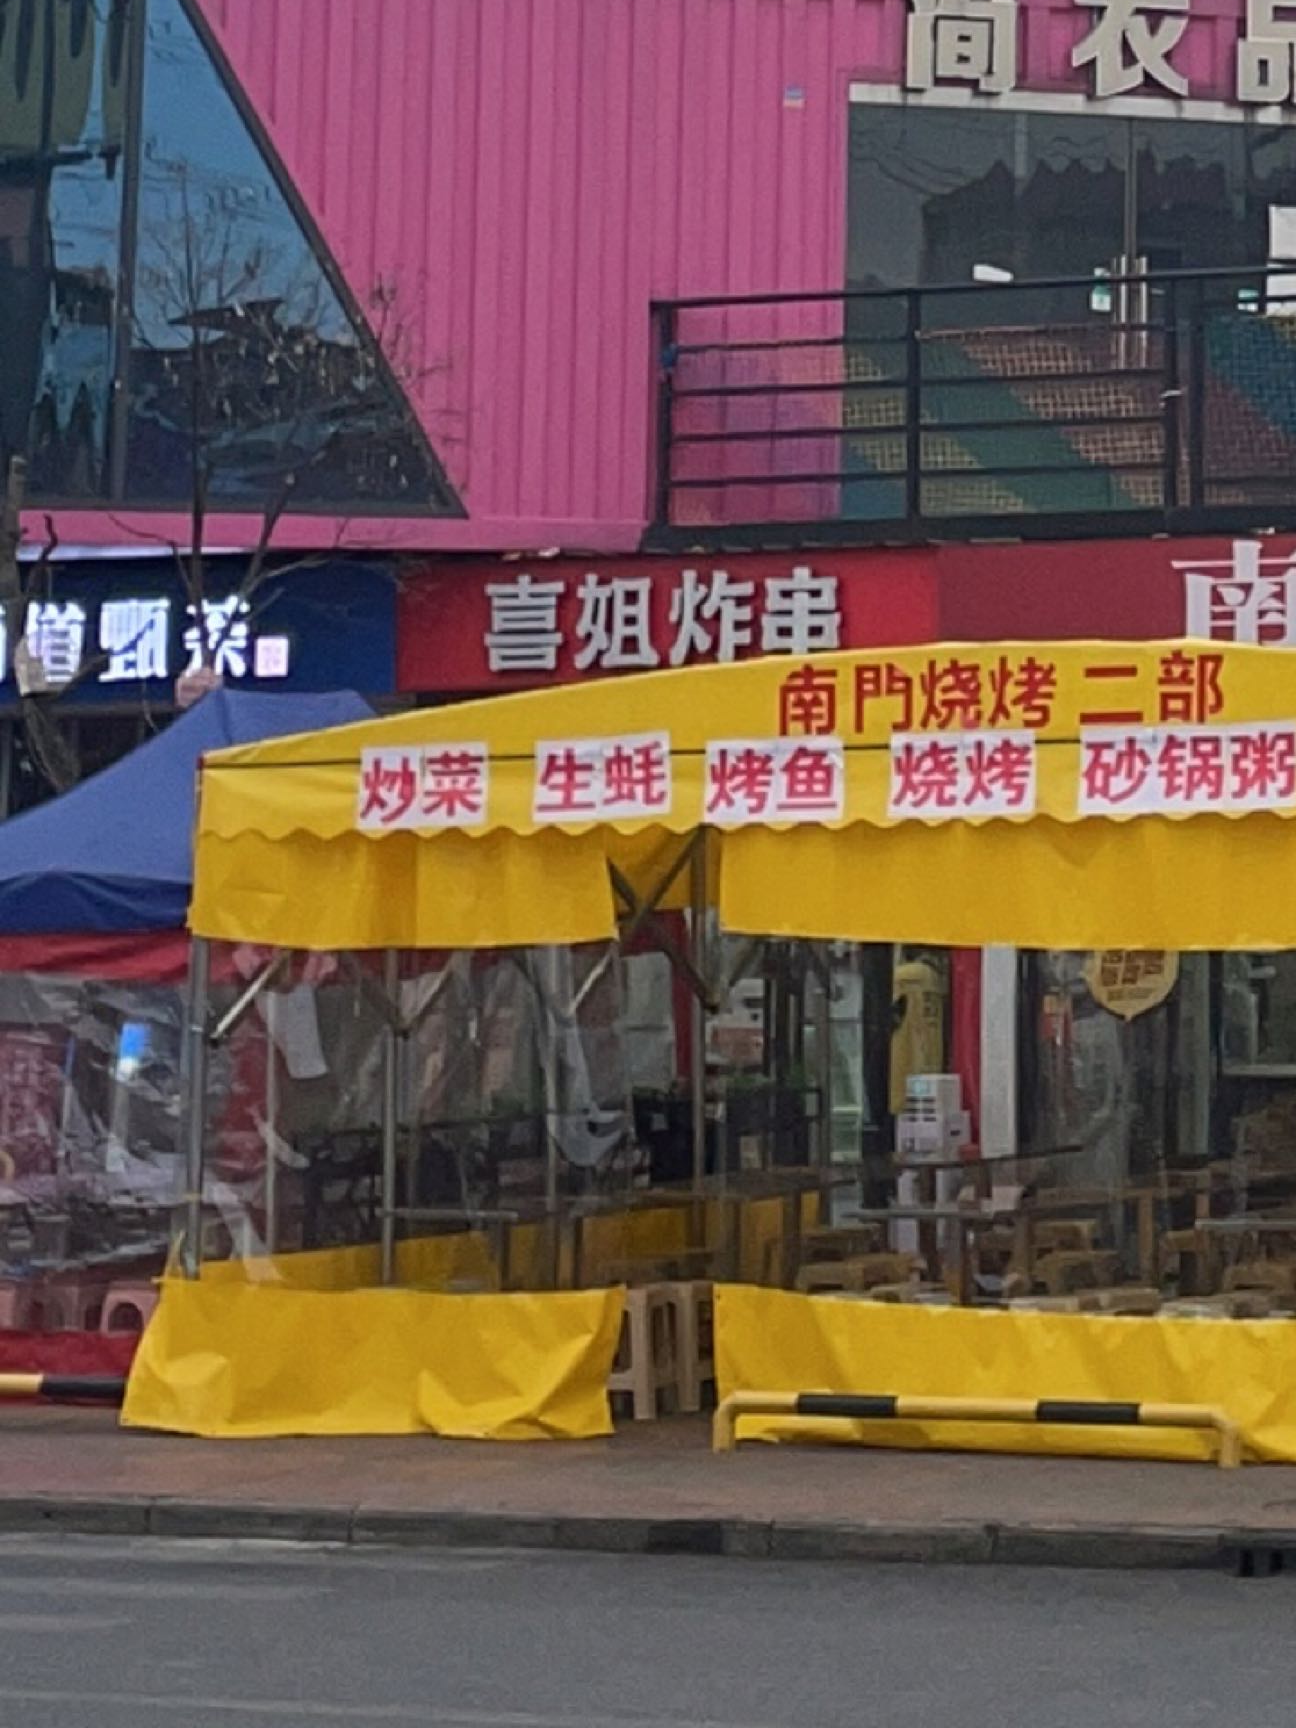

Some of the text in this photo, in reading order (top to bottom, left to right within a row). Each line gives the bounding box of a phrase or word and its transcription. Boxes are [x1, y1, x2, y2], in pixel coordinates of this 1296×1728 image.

[484, 566, 842, 671] 喜姐炸串
[360, 750, 485, 823] 炒菜
[536, 740, 667, 813] 生蚝
[707, 746, 837, 815] 烤鱼
[893, 736, 1033, 808] 烧烤
